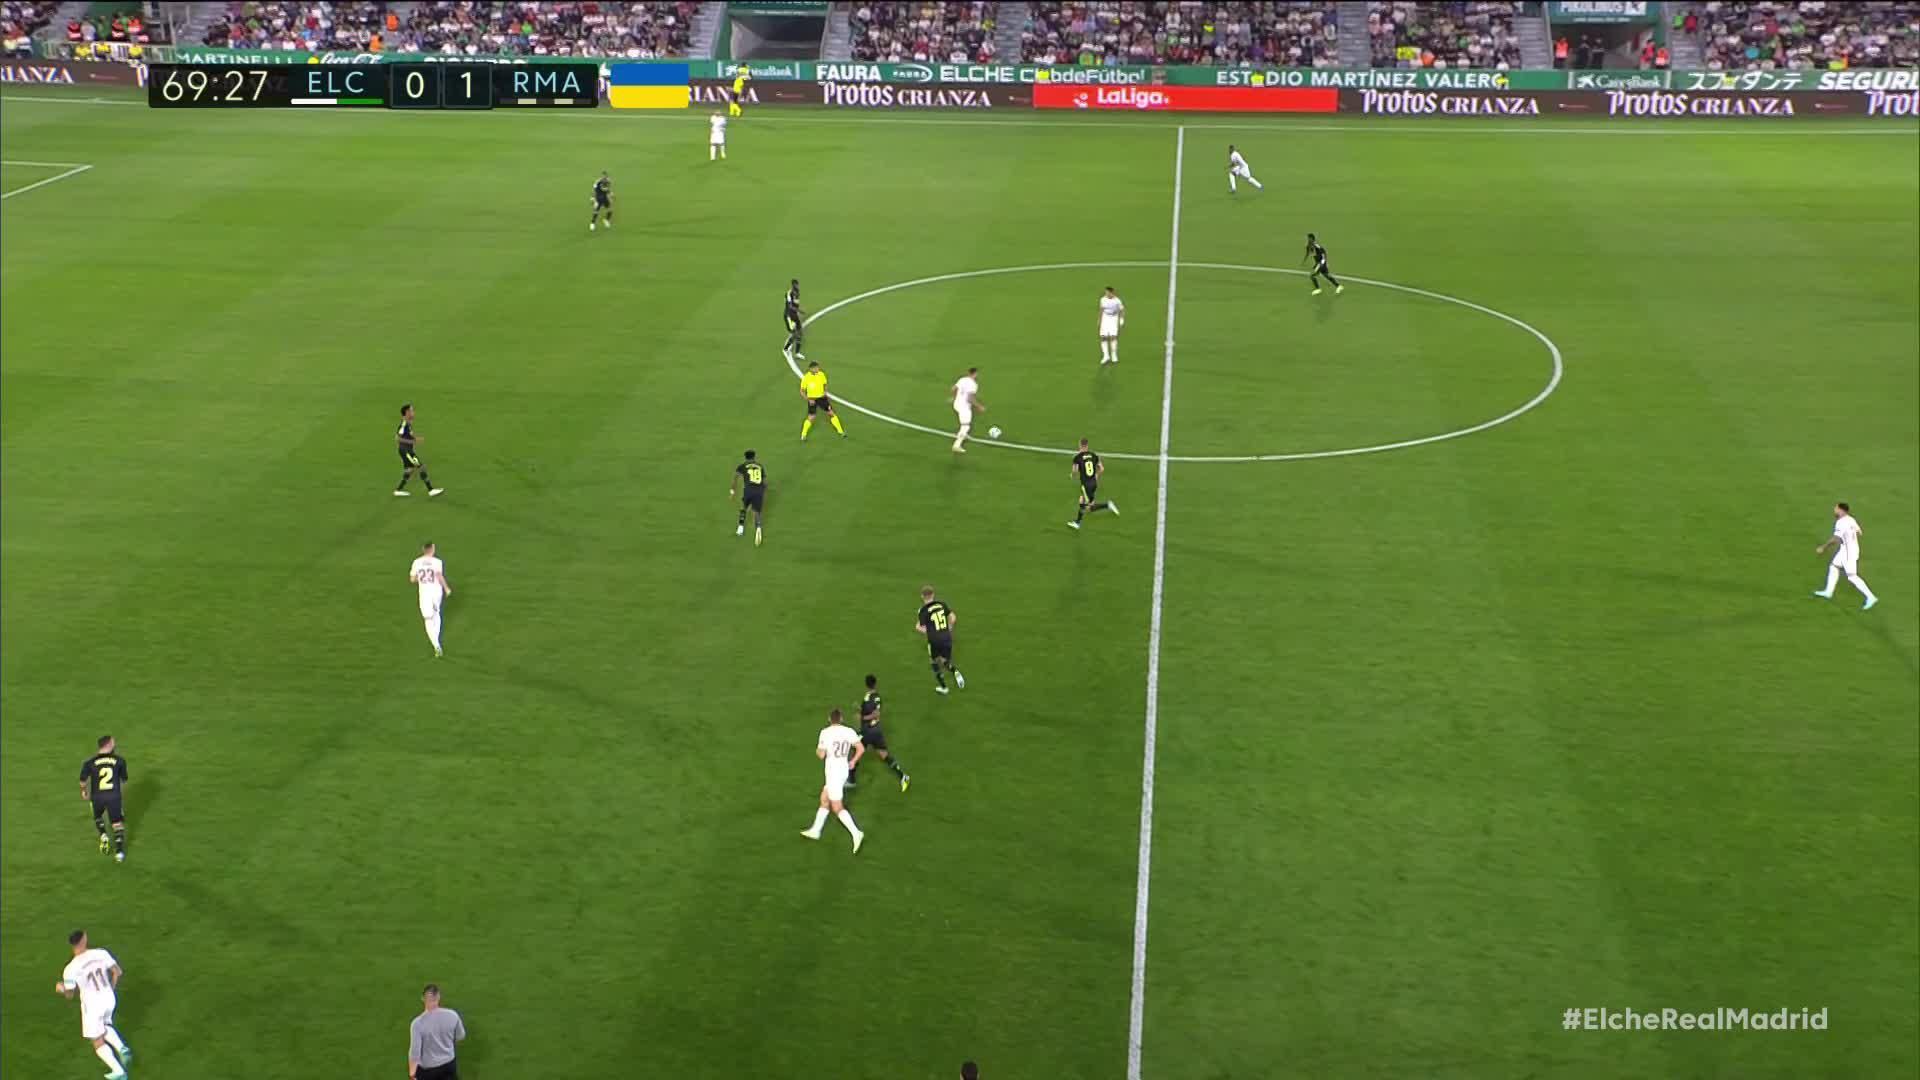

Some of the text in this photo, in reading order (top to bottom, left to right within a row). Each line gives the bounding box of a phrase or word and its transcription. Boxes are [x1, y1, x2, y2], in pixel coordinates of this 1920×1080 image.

[816, 65, 882, 81] FAURA
[940, 66, 1014, 82] ELCHE
[1216, 71, 1304, 86] ESTDIO
[1311, 69, 1417, 87] MARTÍNEZ
[818, 81, 992, 107] Protos CRIANZA
[1097, 87, 1164, 108] LaLiga
[1359, 88, 1540, 115] Protos CRIANZA
[1605, 90, 1796, 115] Protos CRIANZA
[1084, 460, 1095, 477] 8
[418, 568, 436, 585] 23
[930, 609, 948, 631] 15
[832, 740, 850, 759] 20
[98, 767, 114, 790] 2
[86, 967, 109, 992] 11
